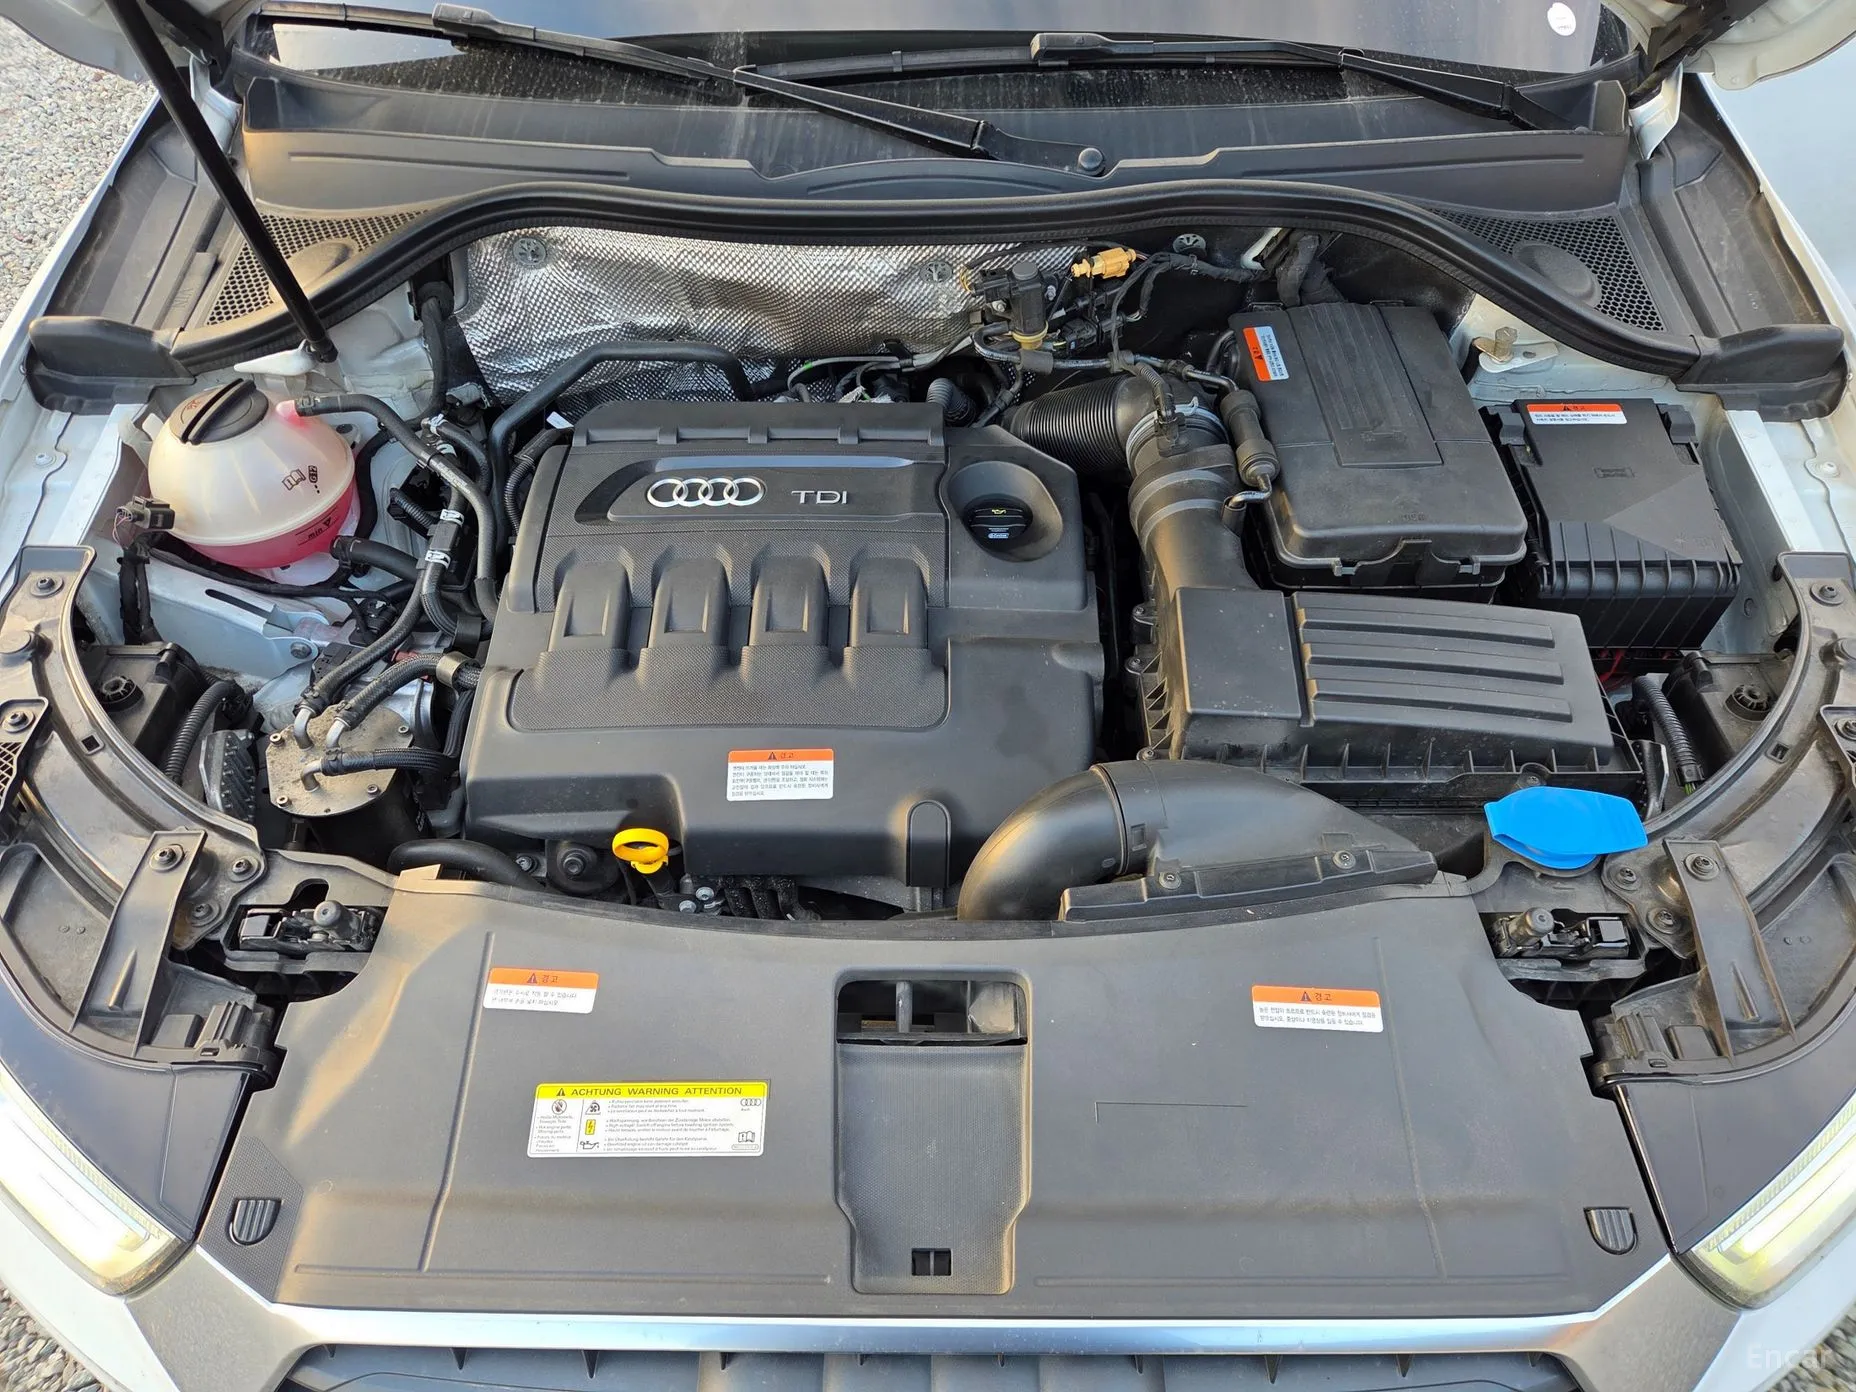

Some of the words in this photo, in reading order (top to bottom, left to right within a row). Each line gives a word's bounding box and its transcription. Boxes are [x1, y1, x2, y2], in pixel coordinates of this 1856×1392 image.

[791, 490, 847, 504] TDI
[308, 527, 323, 539] min
[571, 1088, 622, 1096] ACHTUNG
[627, 1087, 679, 1096] WARNING
[684, 1087, 742, 1095] ATTENTION
